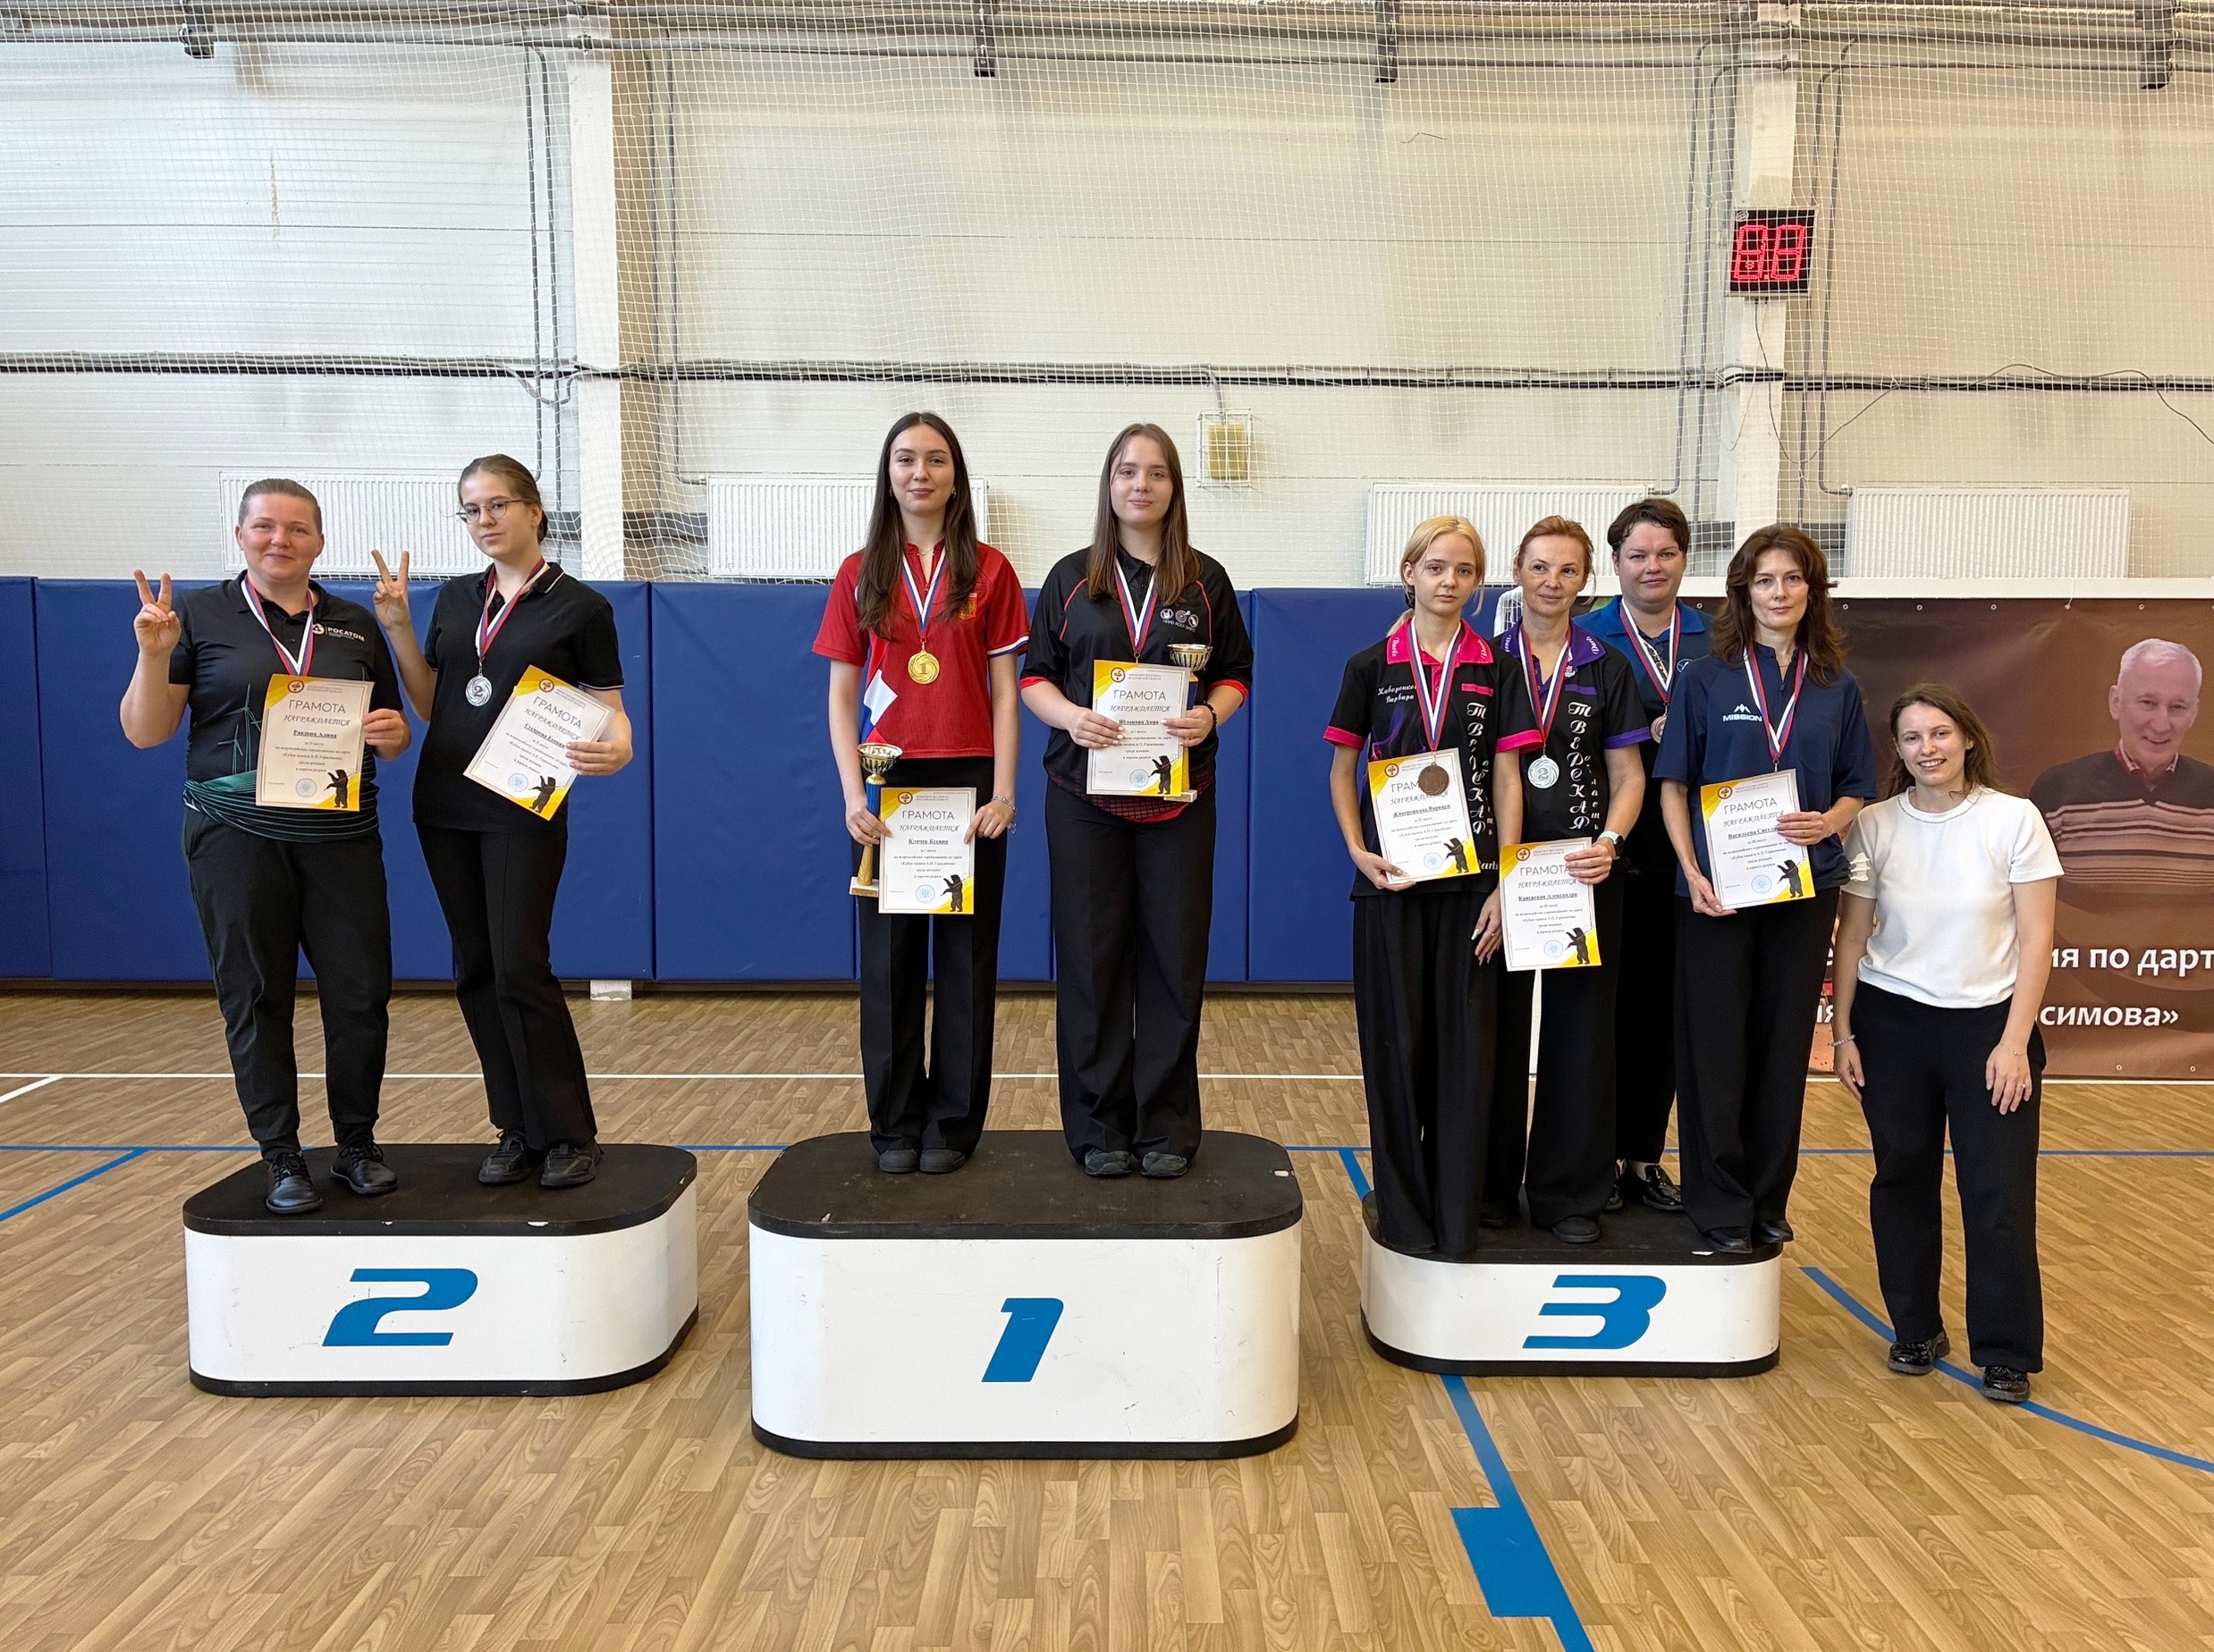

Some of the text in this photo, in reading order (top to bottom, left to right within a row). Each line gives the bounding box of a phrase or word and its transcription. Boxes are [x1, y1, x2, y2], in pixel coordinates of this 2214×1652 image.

[1504, 634, 1512, 653] Dart
[919, 662, 928, 675] 1
[474, 685, 484, 697] 2
[1113, 689, 1167, 701] ГРАМОТА
[289, 699, 346, 713] ГРАМОТА
[533, 695, 582, 729] ГРАМОТА
[1109, 704, 1171, 712] НАГРАЖДАЕТСЯ
[283, 714, 351, 727] НАГРАЖДАЕТСЯ
[1722, 714, 1762, 722] MISSION
[1537, 767, 1549, 780] 2
[1391, 781, 1420, 793] ГРАМ
[1724, 797, 1779, 815] ГРАМОТА
[902, 810, 955, 820] ГРАМОТА
[899, 824, 960, 832] НАГРАЖДАЕТСЯ
[1478, 859, 1499, 871] arts
[1517, 877, 1577, 889] НАГРАЖДАЕТСЯ
[2089, 948, 2130, 969] по
[2040, 1005, 2180, 1027] симова»
[322, 1268, 478, 1346] 2
[1522, 1275, 1667, 1349] 3
[981, 1298, 1064, 1382] 1
